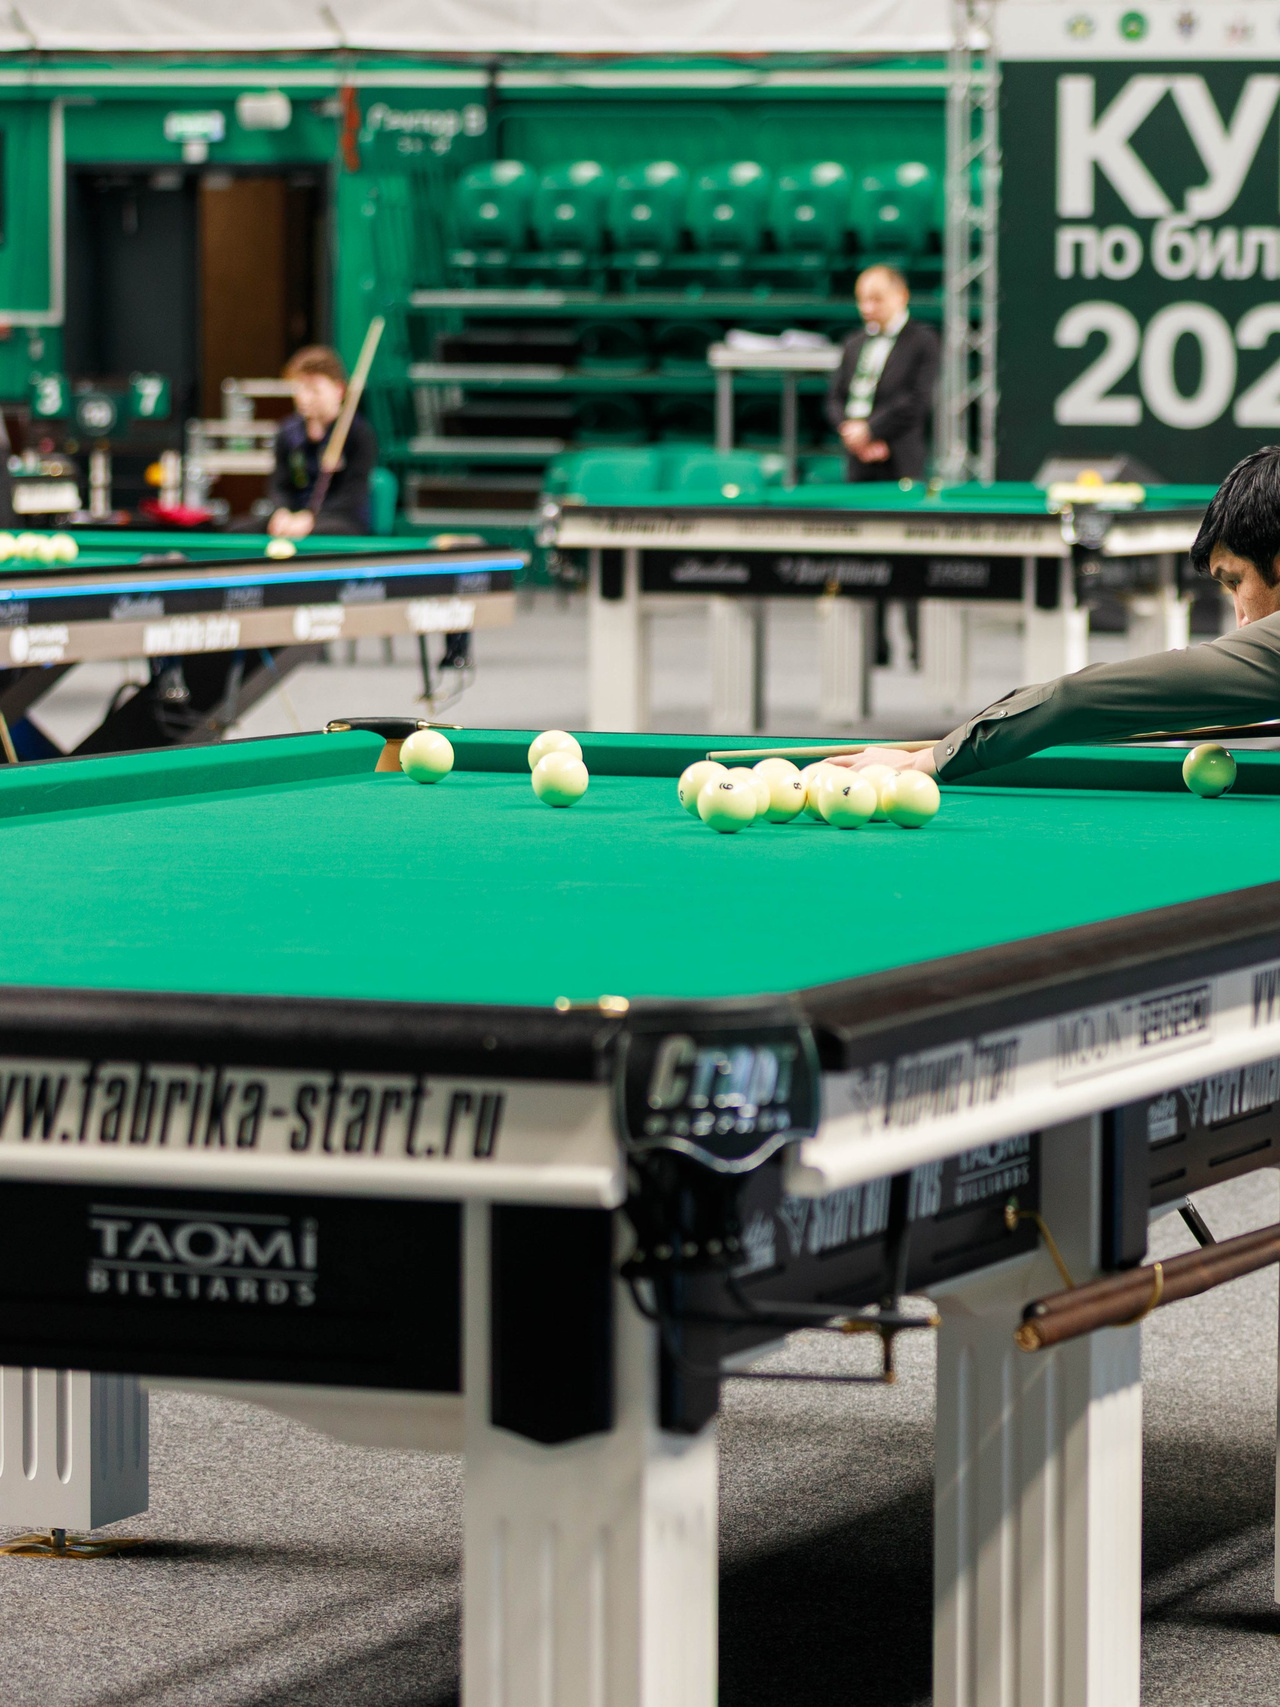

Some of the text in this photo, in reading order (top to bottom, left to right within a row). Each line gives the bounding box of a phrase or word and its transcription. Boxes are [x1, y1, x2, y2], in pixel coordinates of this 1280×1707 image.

[1055, 225, 1143, 281] по
[0, 1062, 506, 1158] w.fabrika-start.ru
[87, 1267, 317, 1306] BILLIARDS
